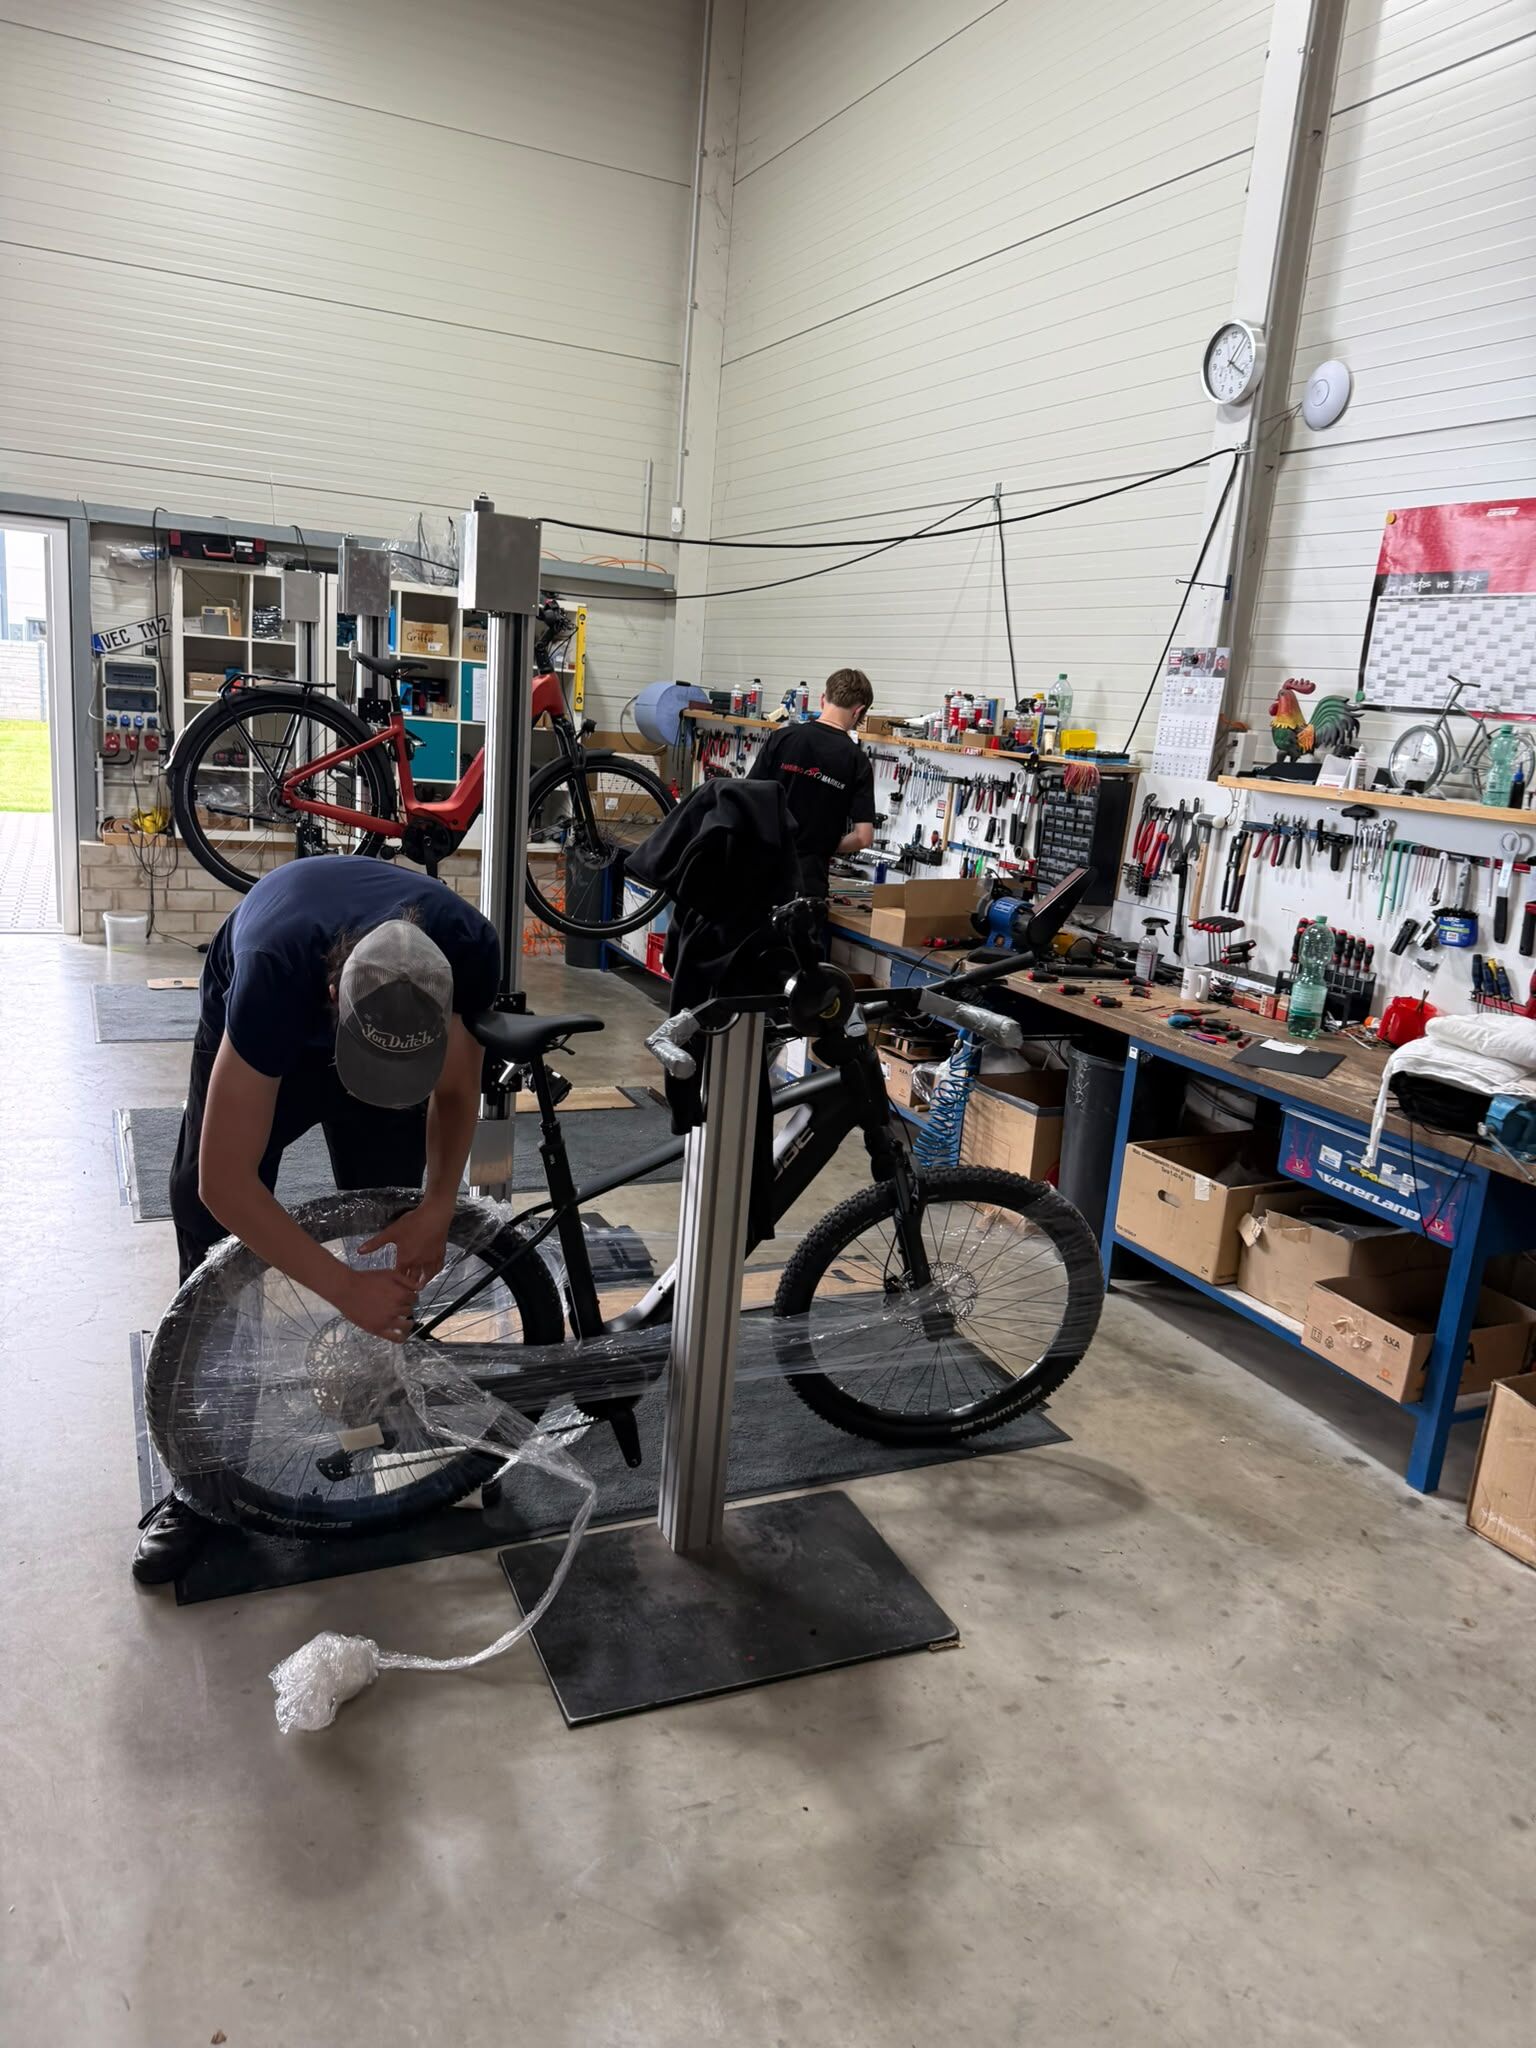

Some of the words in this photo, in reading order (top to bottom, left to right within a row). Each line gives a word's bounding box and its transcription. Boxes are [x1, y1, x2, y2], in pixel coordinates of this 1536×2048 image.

[100, 629, 131, 649] VEC
[366, 1023, 388, 1048] Von
[387, 1030, 435, 1049] Dutch
[1383, 1335, 1400, 1350] AXA
[951, 1384, 1042, 1432] SCHWALBE
[232, 1497, 353, 1529] SCHWALBE
